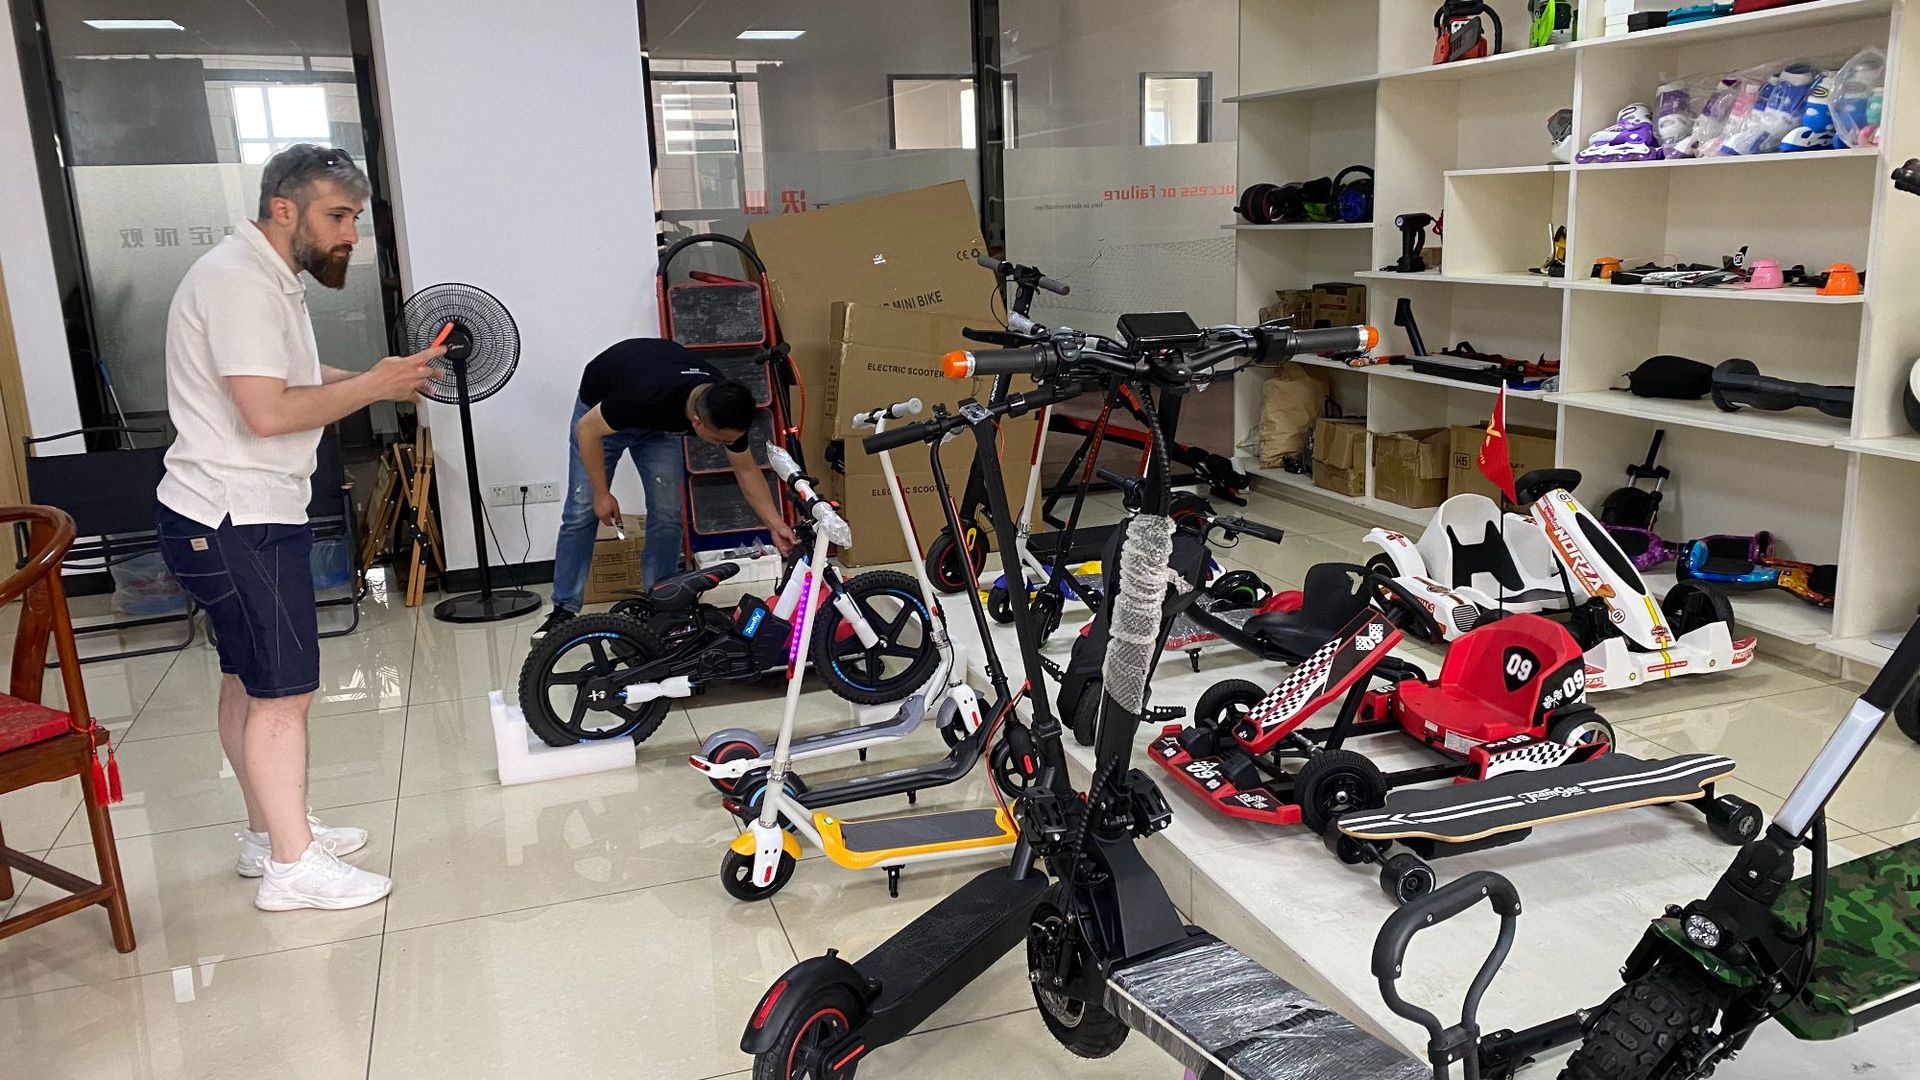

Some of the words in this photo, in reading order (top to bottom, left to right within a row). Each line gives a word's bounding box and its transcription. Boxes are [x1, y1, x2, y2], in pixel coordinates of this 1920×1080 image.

[917, 290, 944, 307] BIKE
[867, 363, 907, 375] ELECTRIC
[907, 367, 945, 379] SCOOTER
[1553, 527, 1604, 592] NORZA
[1506, 653, 1533, 682] 09
[1562, 669, 1584, 698] 09
